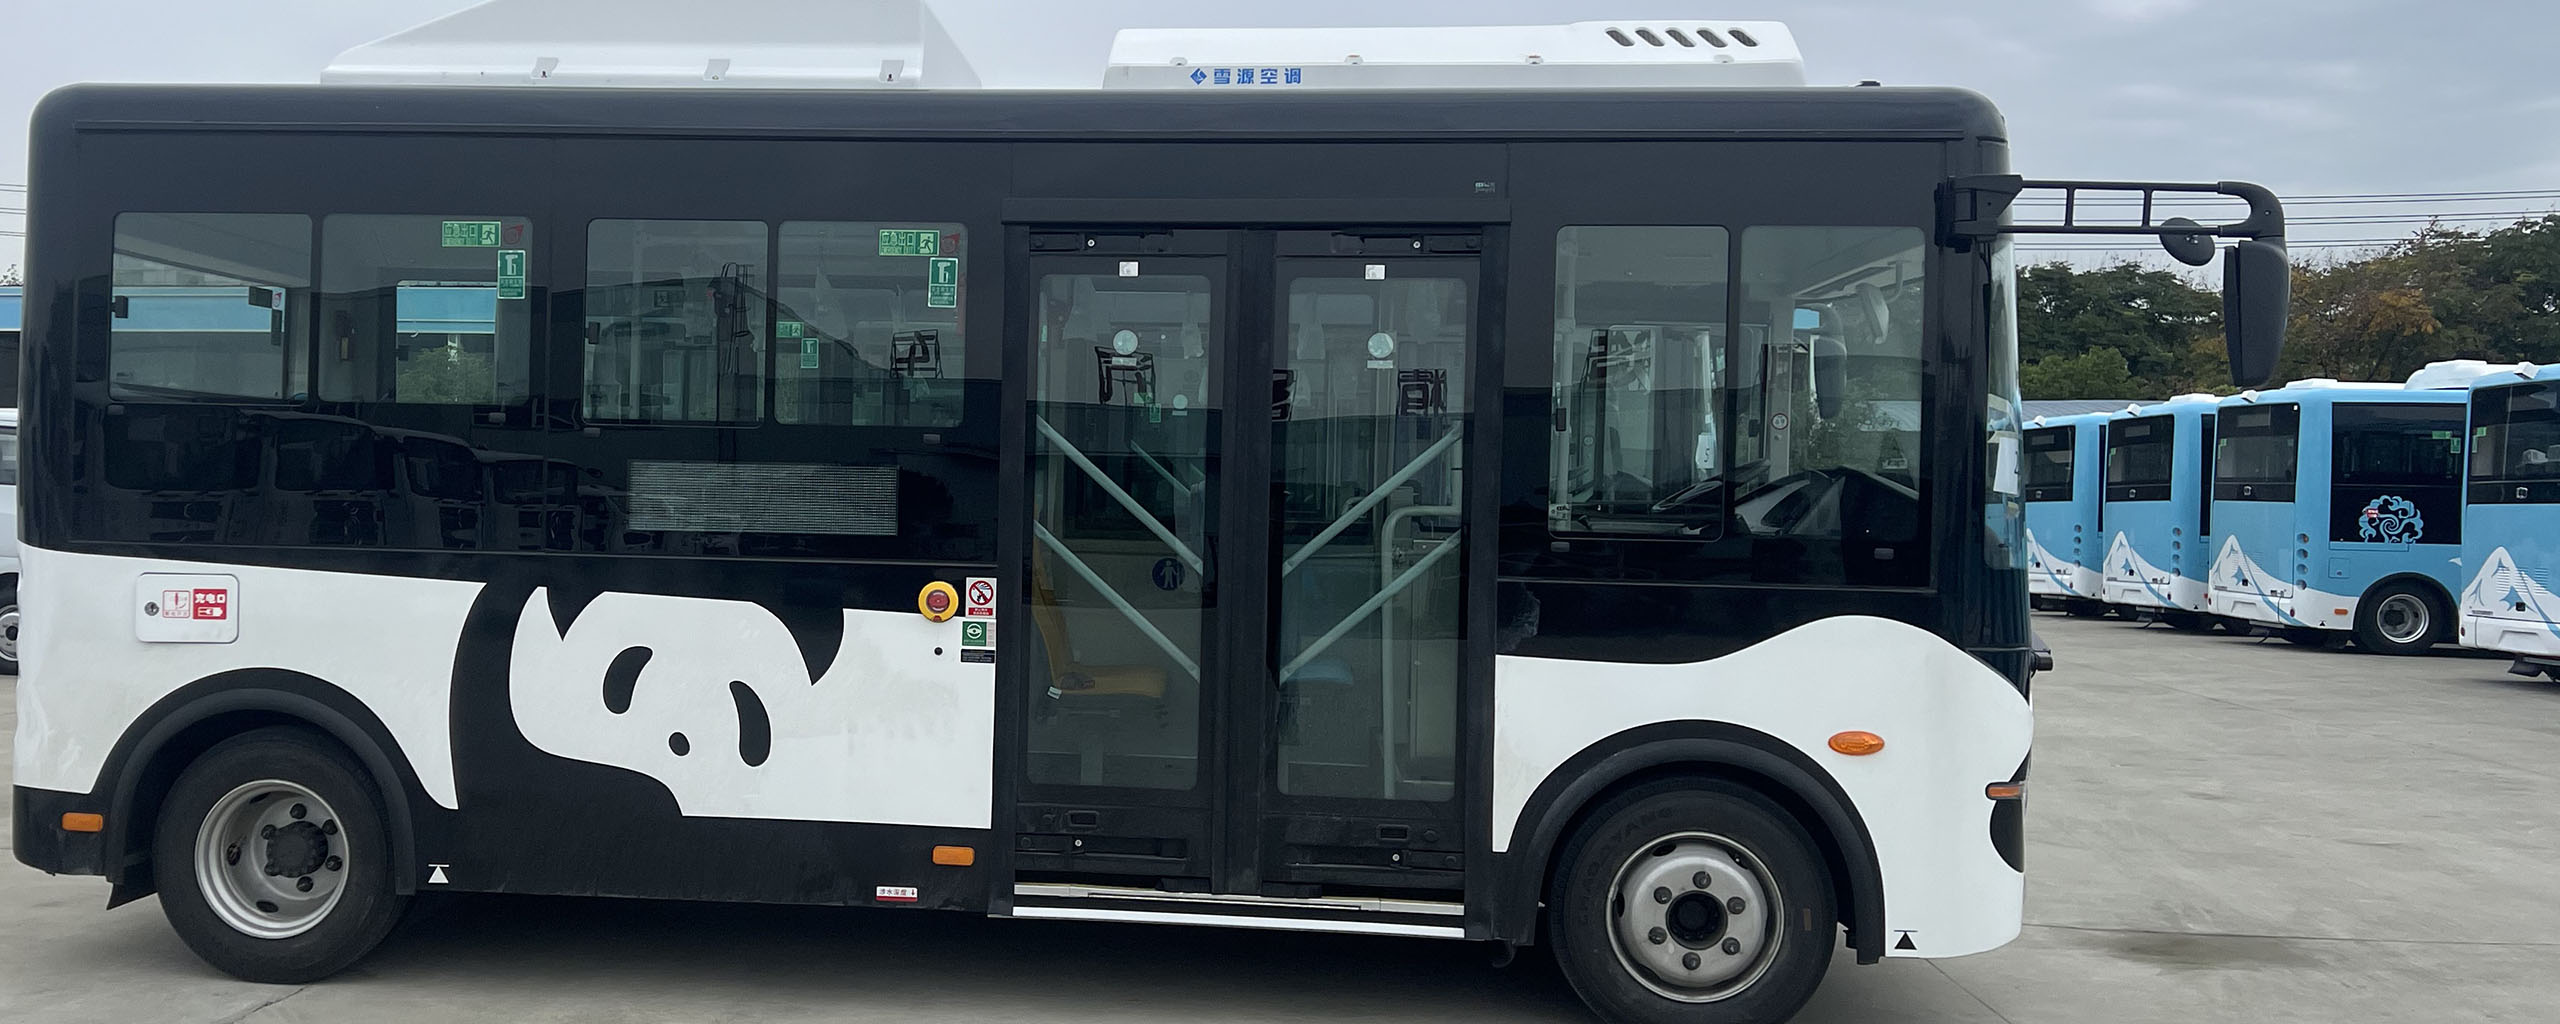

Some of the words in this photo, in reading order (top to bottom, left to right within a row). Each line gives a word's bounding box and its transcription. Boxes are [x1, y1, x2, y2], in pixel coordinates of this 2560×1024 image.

[1213, 68, 1301, 84] 雪源空调
[195, 593, 226, 603] 充电口
